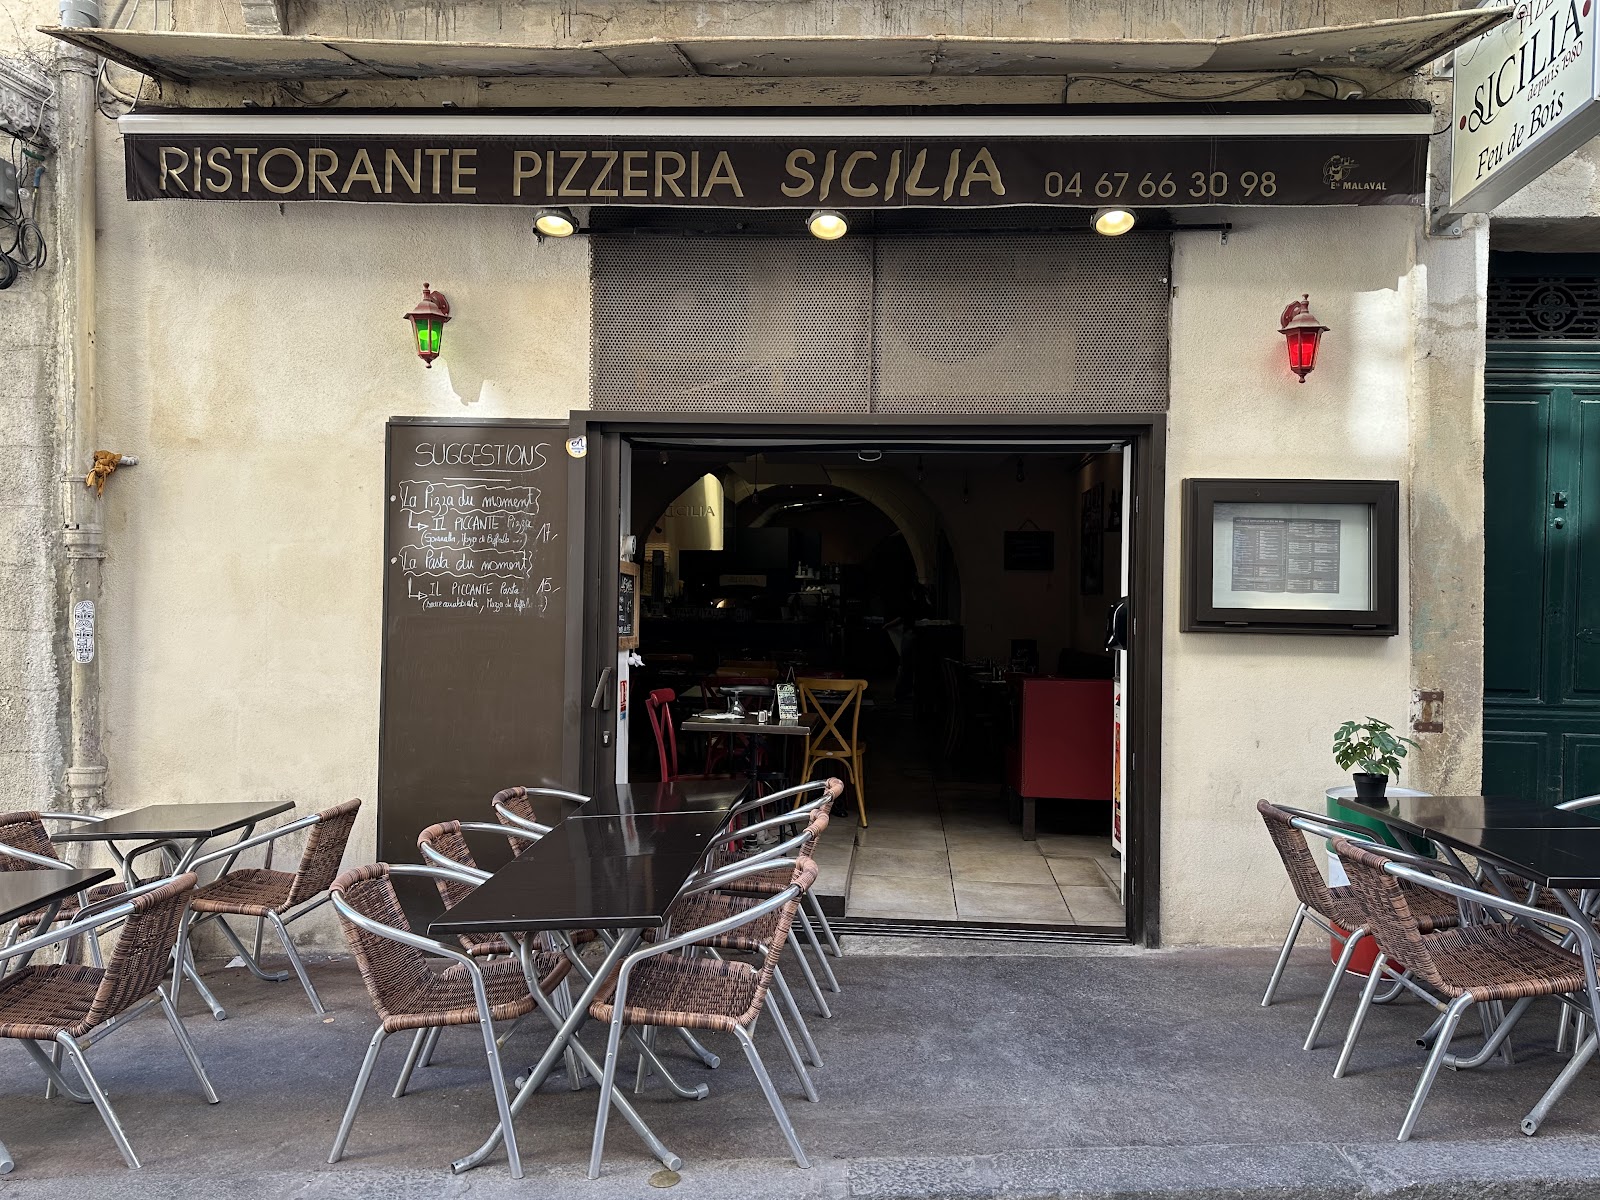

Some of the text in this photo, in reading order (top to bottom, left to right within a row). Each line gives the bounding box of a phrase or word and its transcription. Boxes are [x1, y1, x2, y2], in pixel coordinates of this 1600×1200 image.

[1468, 0, 1583, 133] SICILIA
[1528, 40, 1583, 101] depuis 1980
[1476, 89, 1564, 180] Feu de Bois
[158, 146, 1006, 202] RISTORANTE PIZZERIA SICILIA
[1044, 171, 1277, 198] 04 67 66 30 98
[1343, 181, 1387, 190] MALAVAL
[415, 442, 551, 470] SUGGESTIONS
[403, 483, 533, 517] La Pizza du moment
[431, 516, 446, 530] IL
[507, 514, 534, 533] Pizza
[403, 549, 528, 571] La Pasta du moment
[429, 581, 442, 597] IL
[500, 581, 521, 595] Pasta
